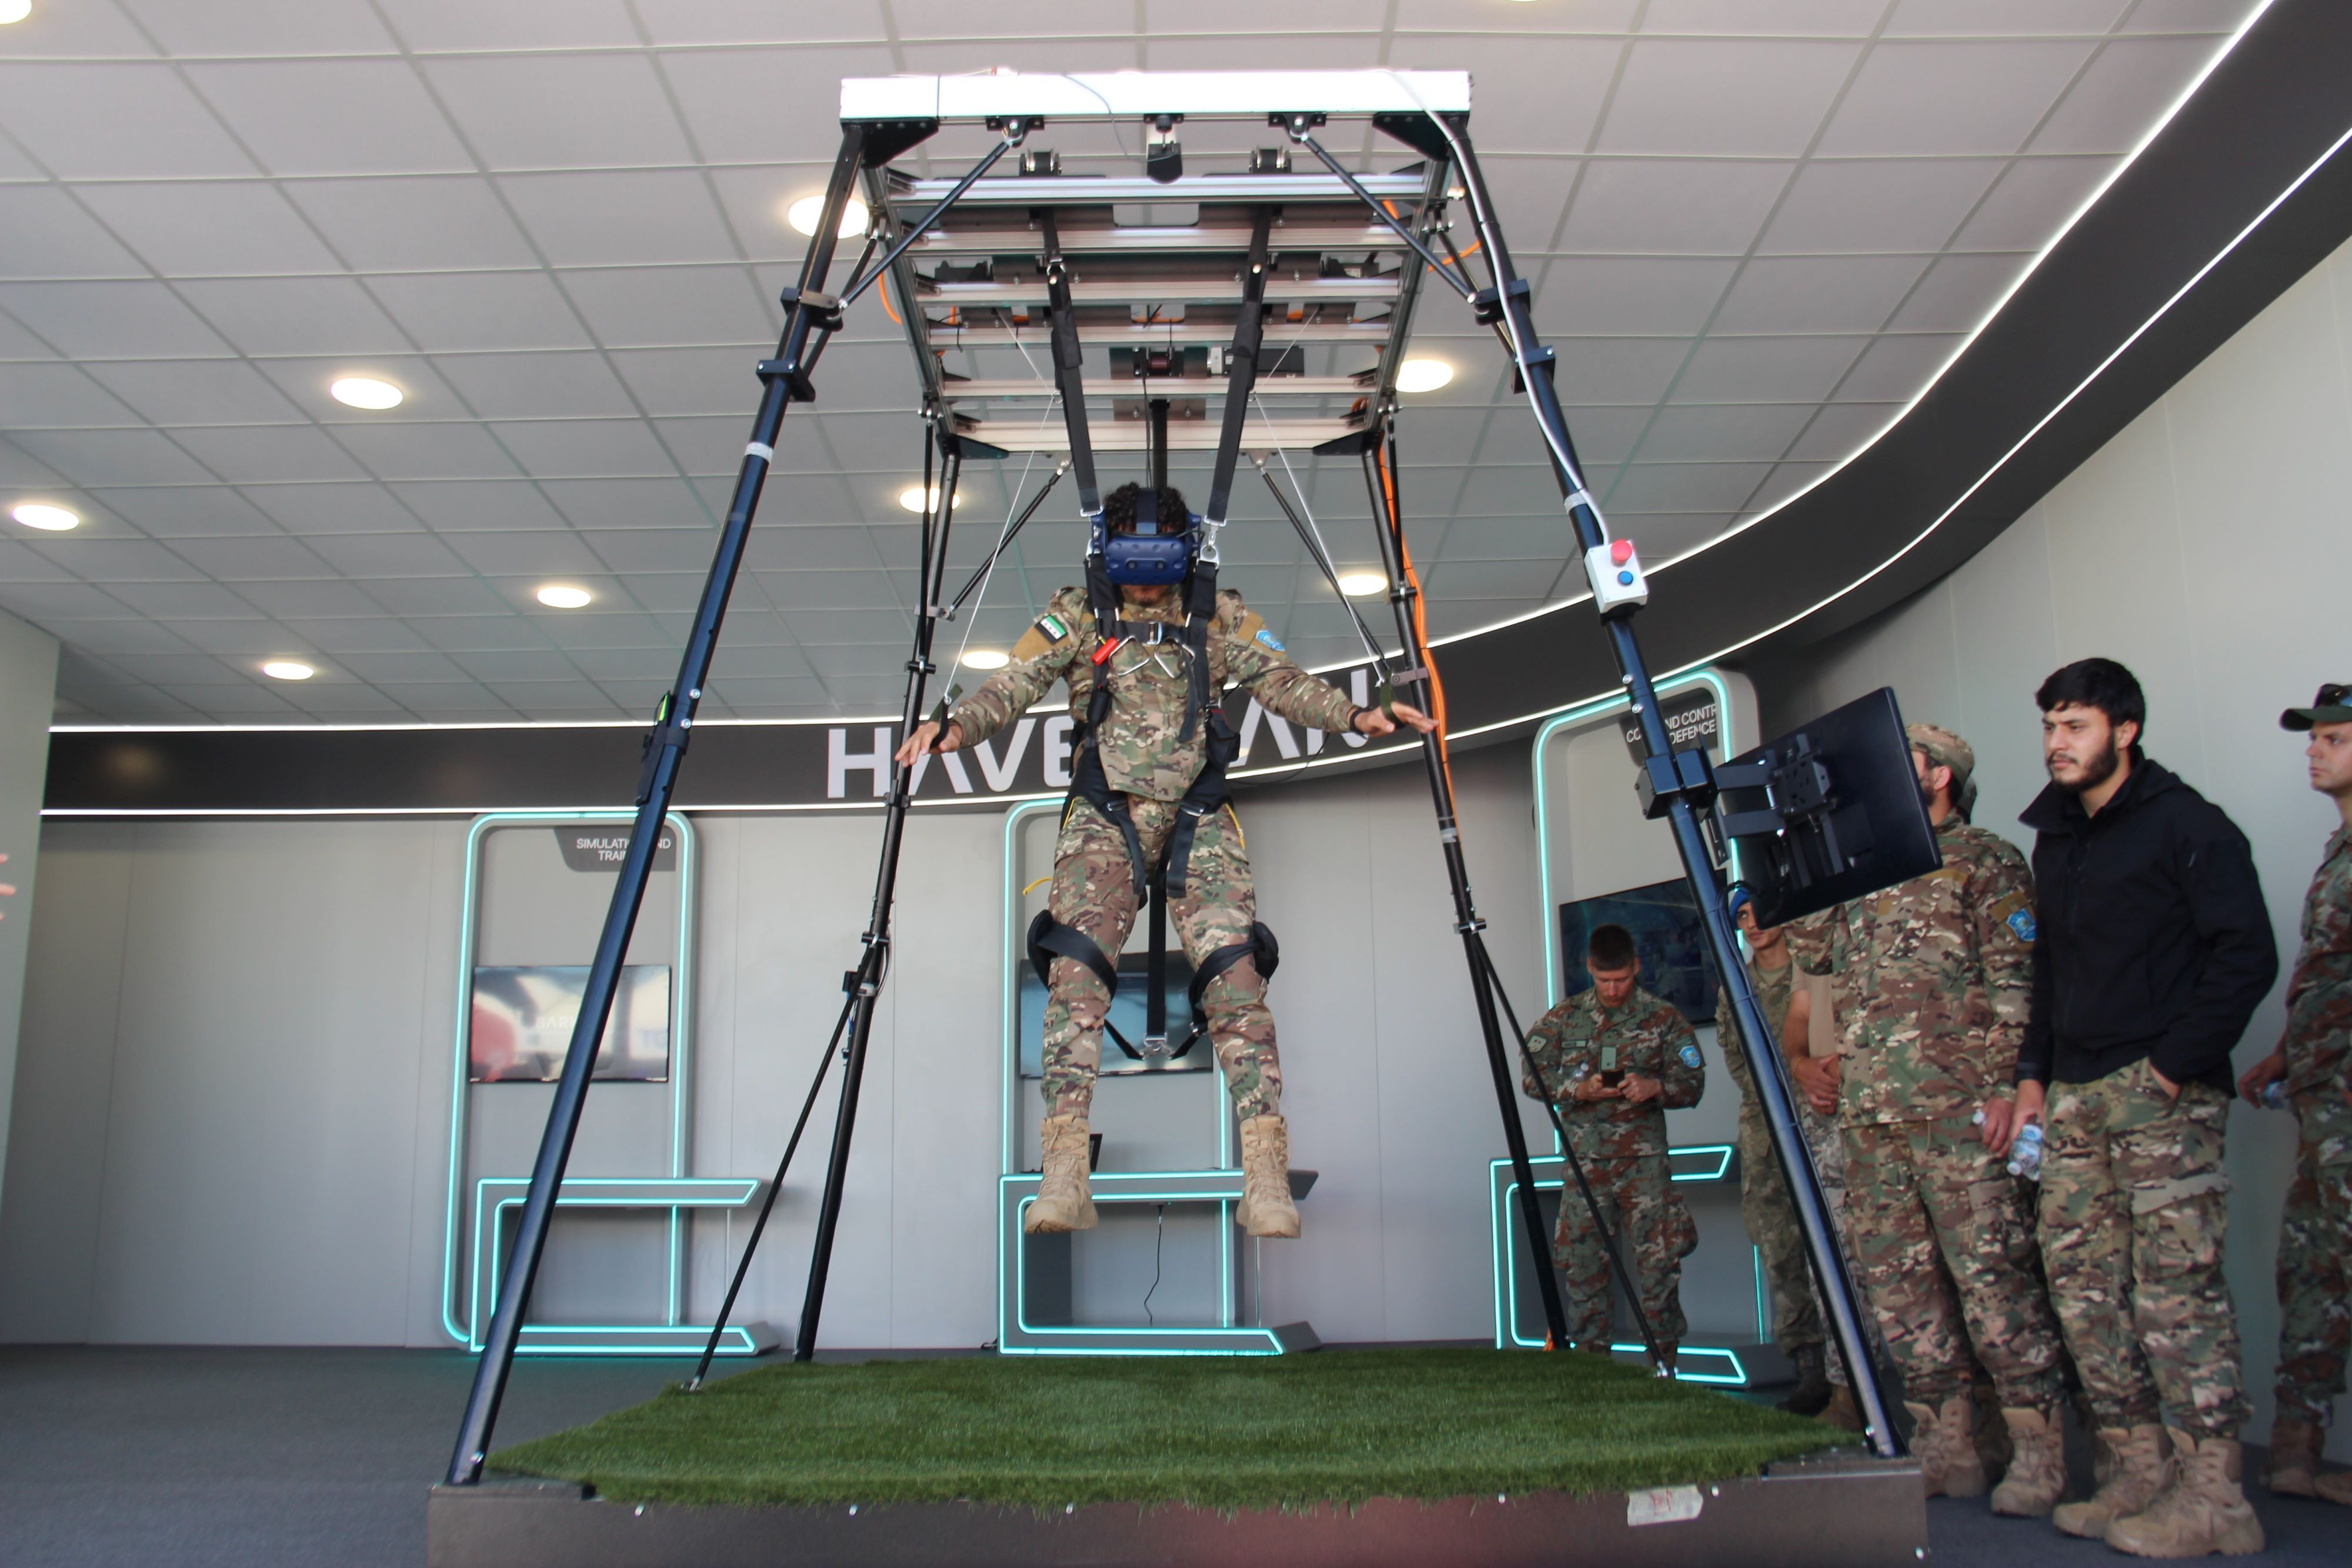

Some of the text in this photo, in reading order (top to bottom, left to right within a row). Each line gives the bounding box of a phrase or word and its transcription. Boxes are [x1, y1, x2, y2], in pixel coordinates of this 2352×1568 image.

[1682, 704, 1716, 725] CONTR
[576, 838, 672, 849] SIMULATI ND
[598, 850, 626, 861] TRAI
